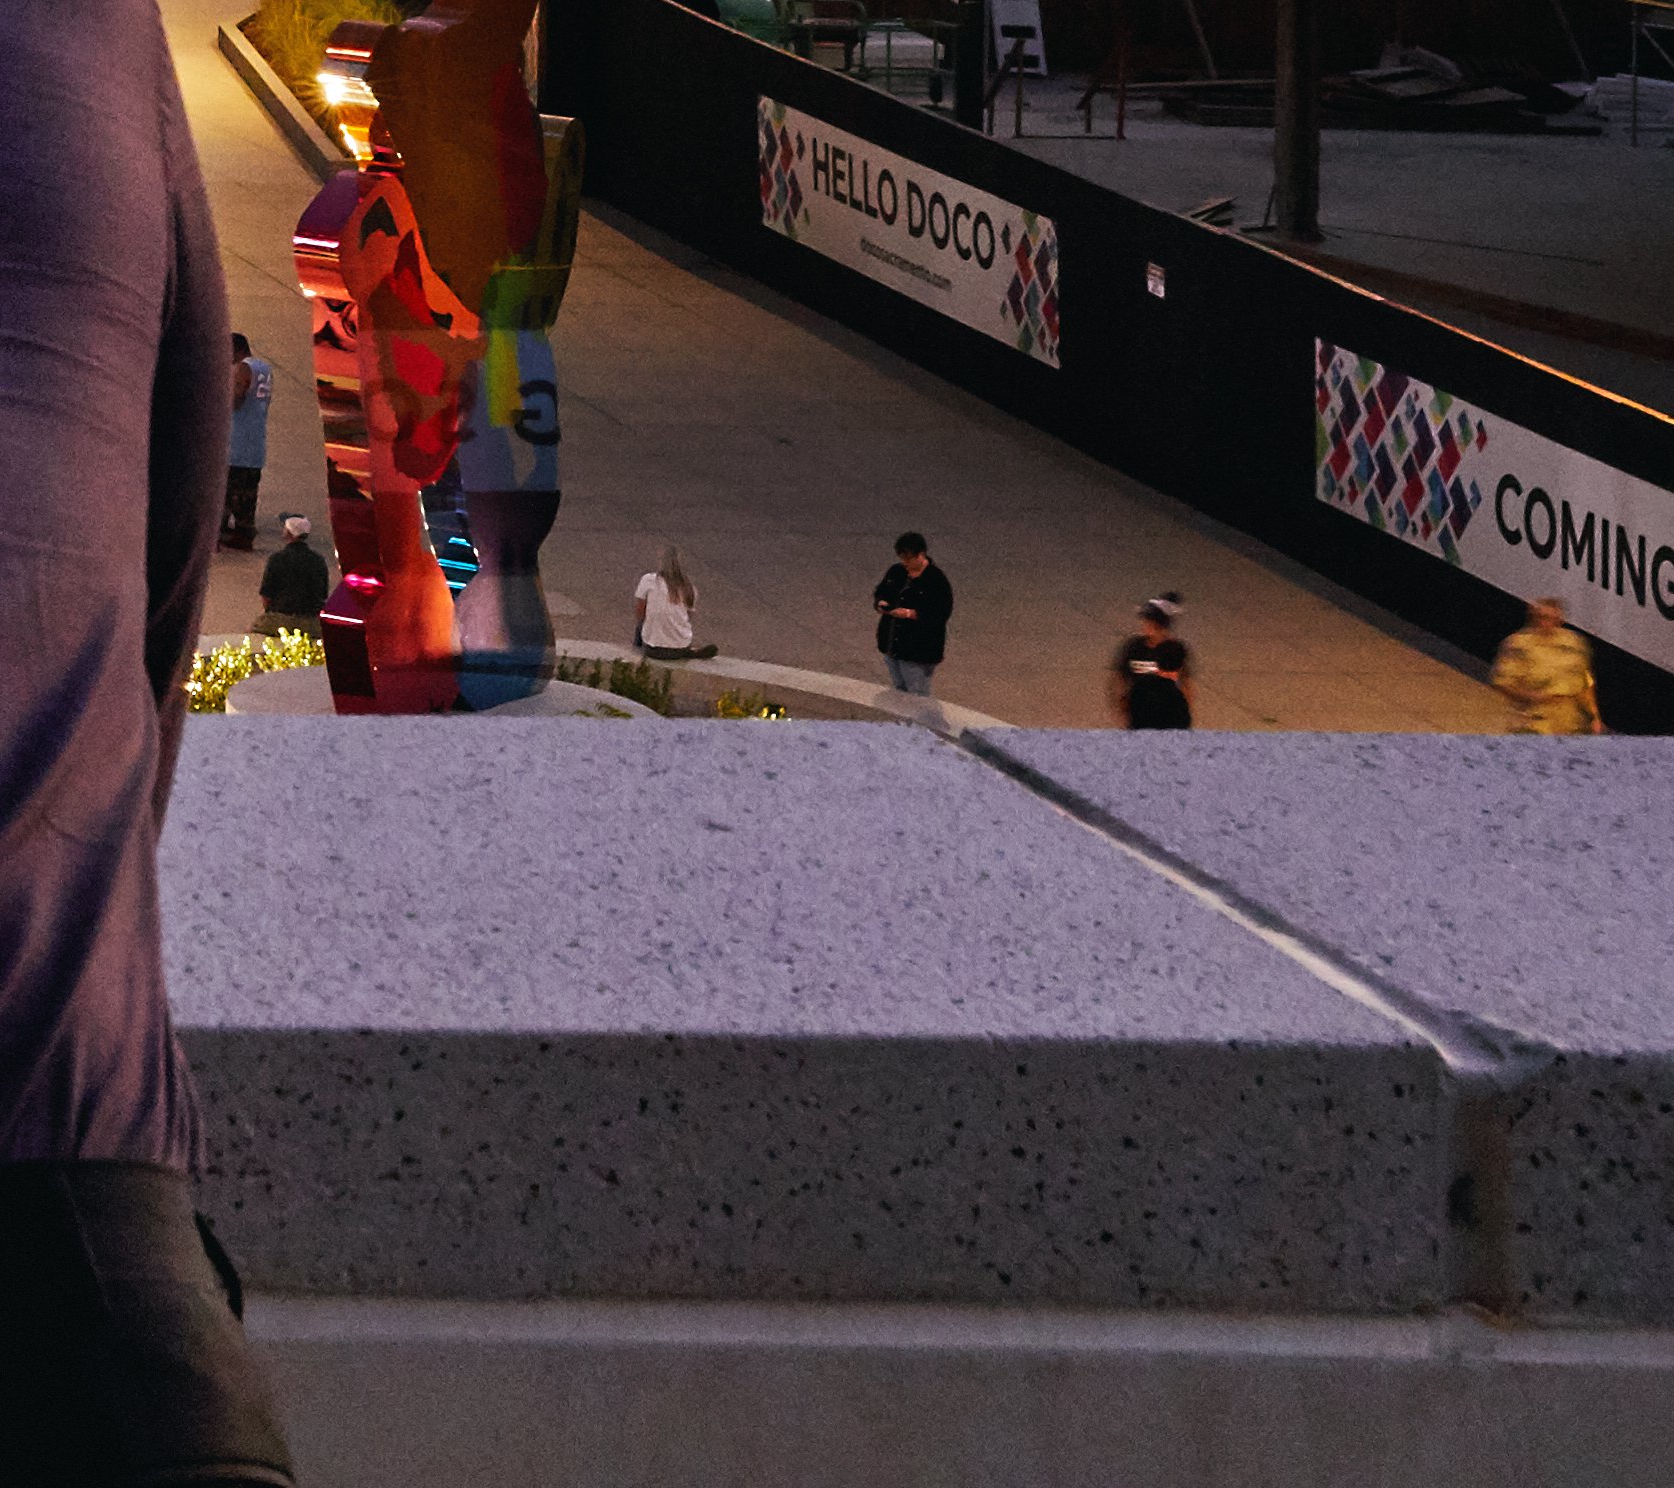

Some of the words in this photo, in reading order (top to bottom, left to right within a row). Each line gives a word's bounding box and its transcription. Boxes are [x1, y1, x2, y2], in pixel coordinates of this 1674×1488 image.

[812, 137, 898, 226] HELLO
[906, 178, 996, 270] DOCO
[1494, 473, 1674, 621] COMING
